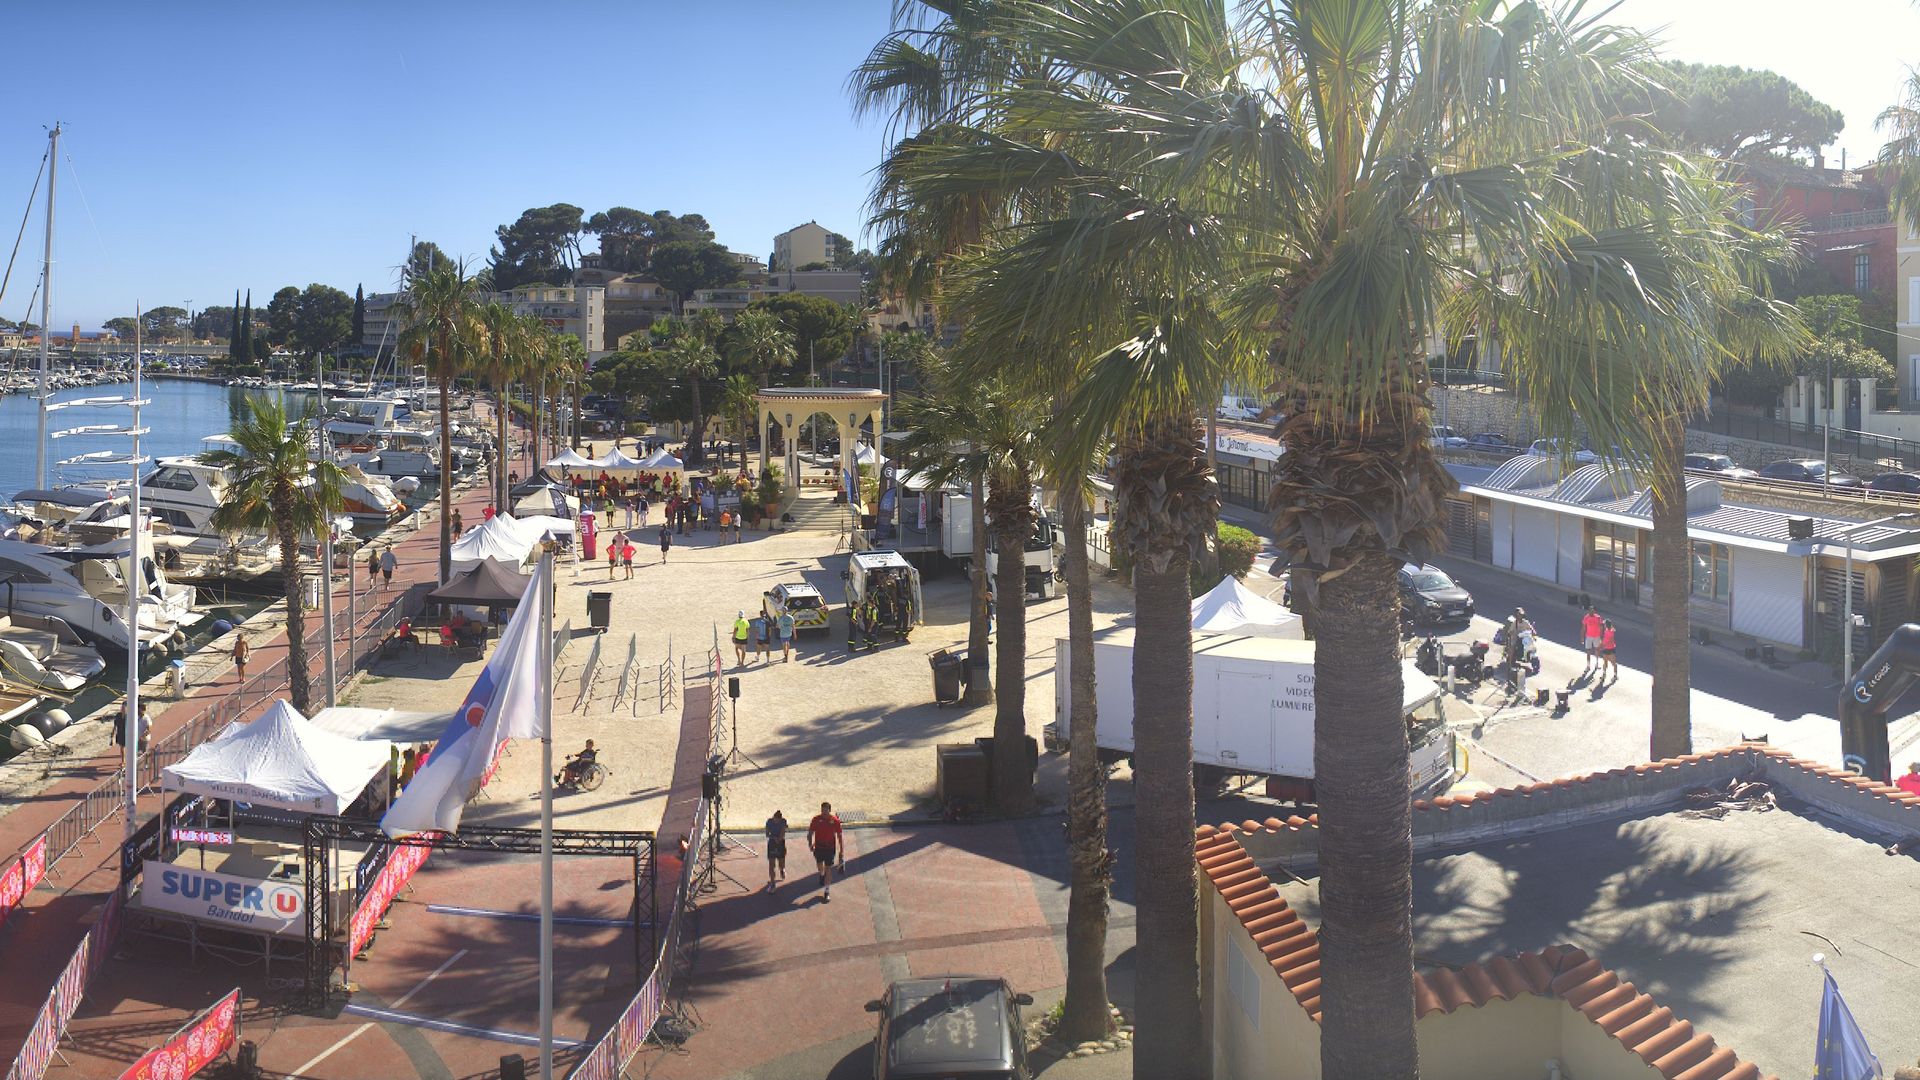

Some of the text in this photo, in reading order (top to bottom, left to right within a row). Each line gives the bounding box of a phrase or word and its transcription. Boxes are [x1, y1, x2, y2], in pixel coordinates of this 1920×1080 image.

[162, 870, 297, 913] SUPER U
[207, 904, 256, 923] Bandol
